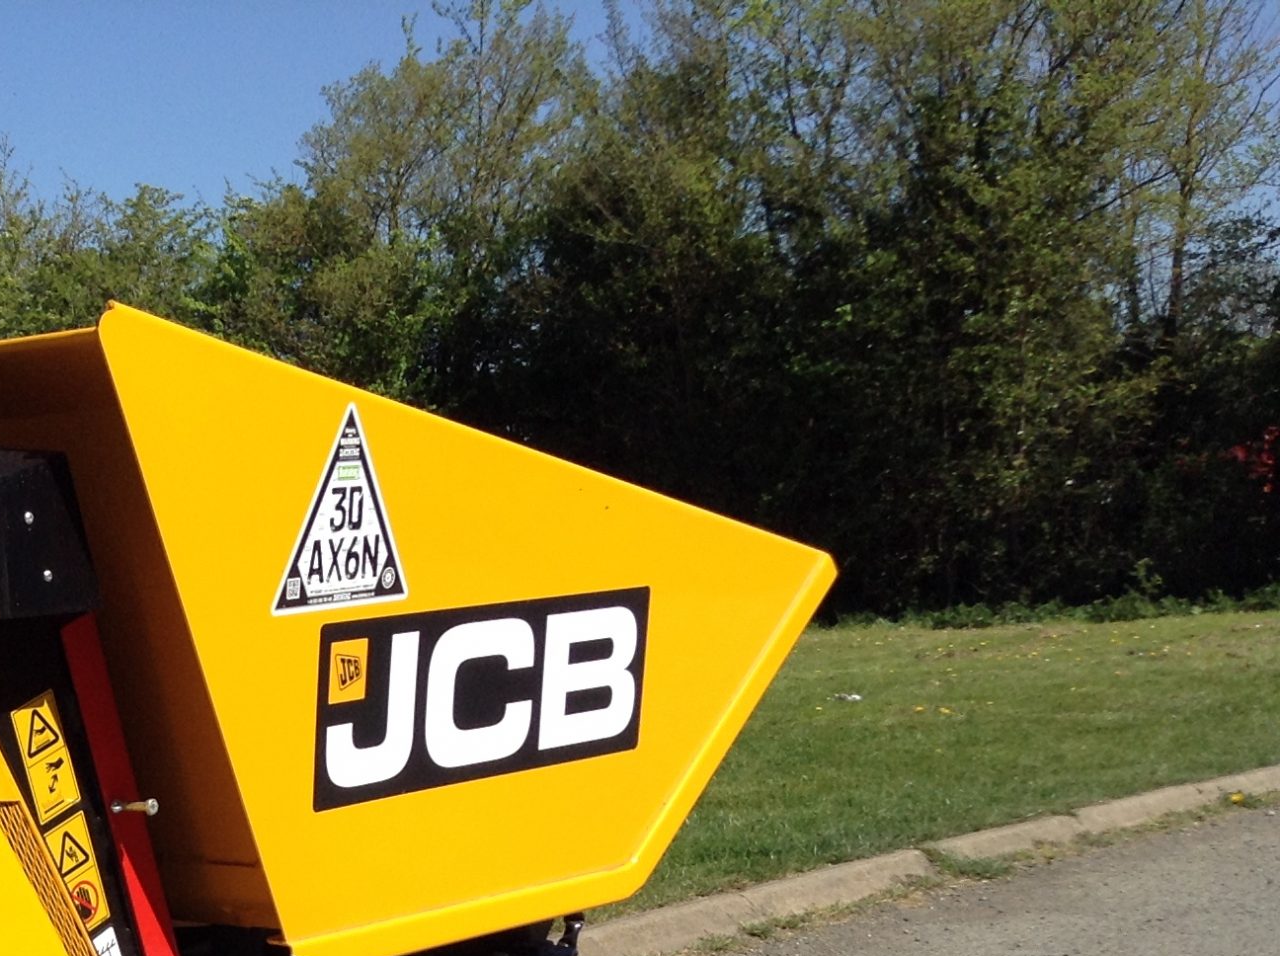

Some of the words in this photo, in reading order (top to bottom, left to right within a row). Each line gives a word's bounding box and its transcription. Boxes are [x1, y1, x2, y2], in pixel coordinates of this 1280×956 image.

[308, 534, 379, 584] AX6N
[338, 658, 360, 682] JCB
[326, 606, 637, 788] JCB
